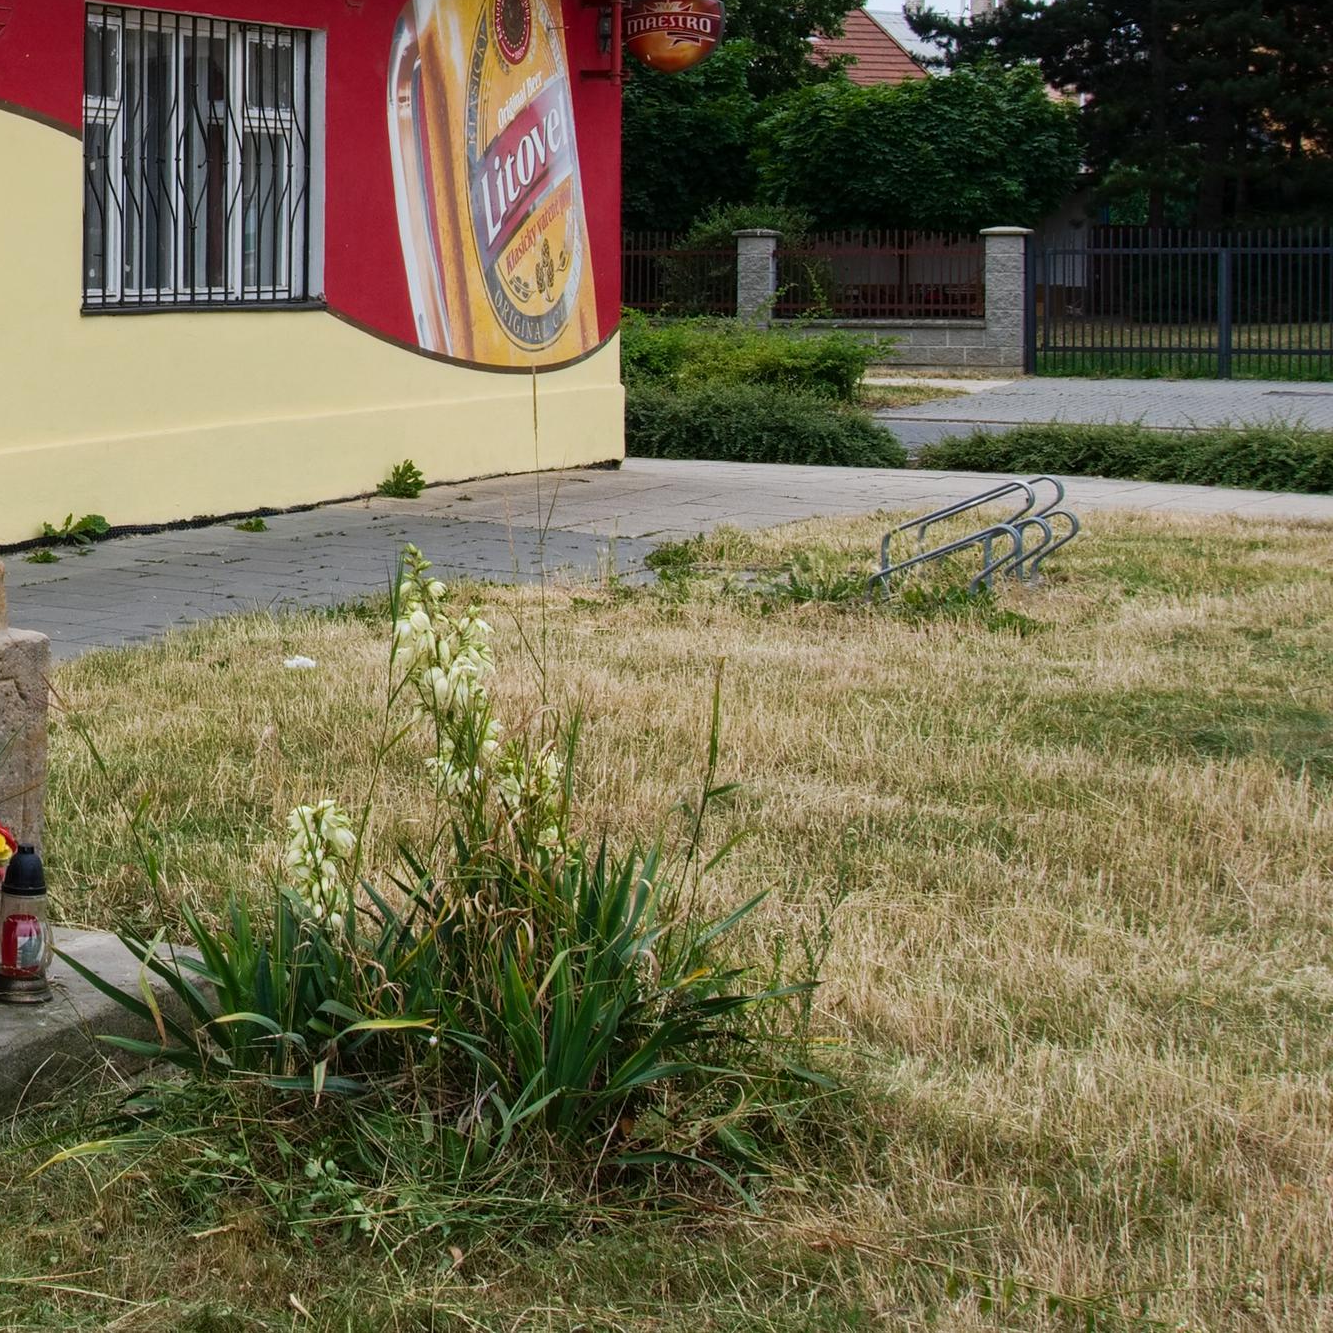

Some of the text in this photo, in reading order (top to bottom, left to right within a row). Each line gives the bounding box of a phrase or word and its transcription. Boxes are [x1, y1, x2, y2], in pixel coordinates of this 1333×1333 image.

[627, 15, 711, 36] MAESTRO
[481, 89, 569, 247] Litovel
[506, 223, 537, 276] Klasicky
[494, 289, 550, 342] ORIGINAL
